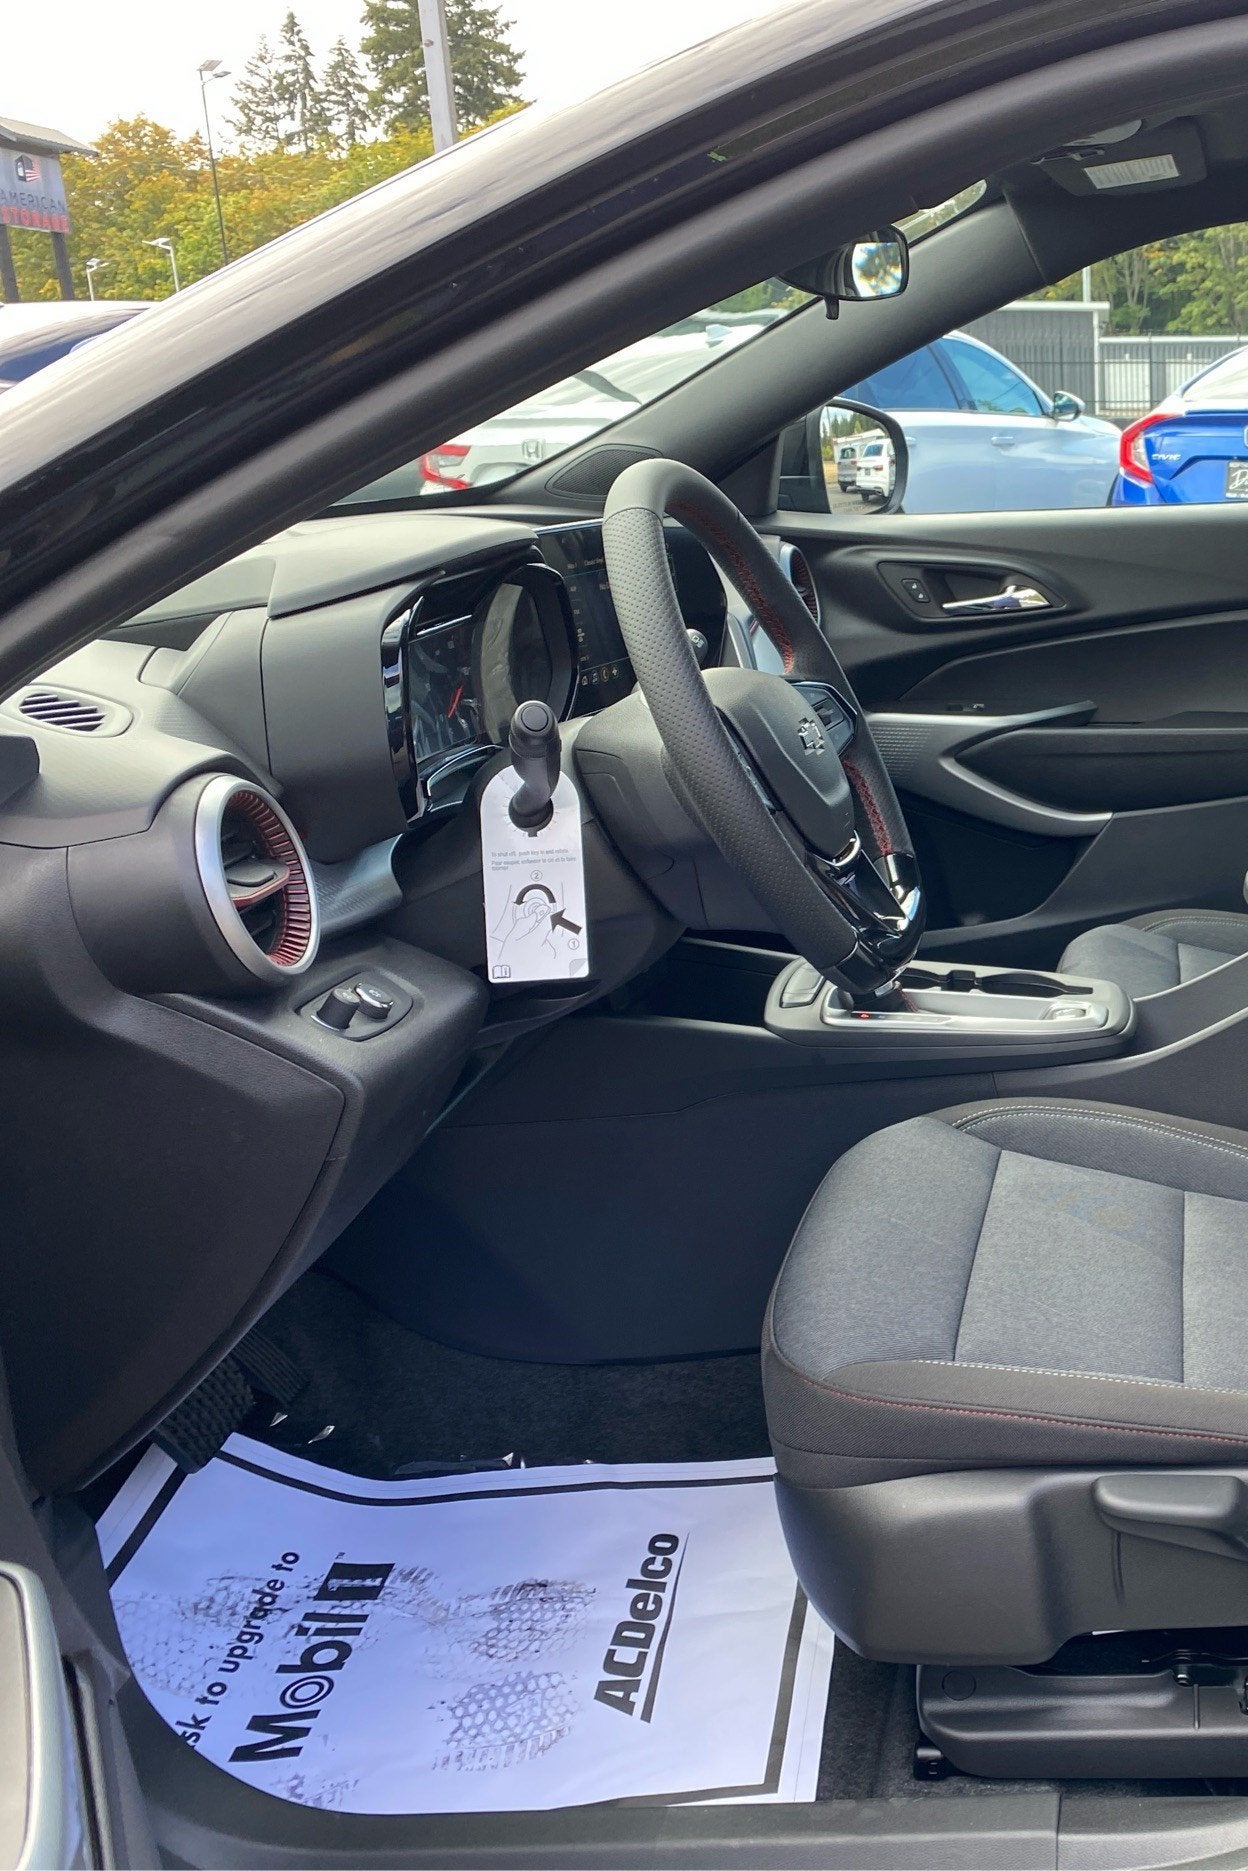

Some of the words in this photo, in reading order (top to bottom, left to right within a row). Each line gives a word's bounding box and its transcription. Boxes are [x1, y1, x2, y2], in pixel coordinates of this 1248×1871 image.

[175, 1713, 213, 1749] sk
[195, 1682, 228, 1706] to
[218, 1579, 285, 1674] upgrade
[271, 1551, 300, 1572] to
[228, 1612, 370, 1763] Mobil
[593, 1533, 680, 1717] ACDelco
